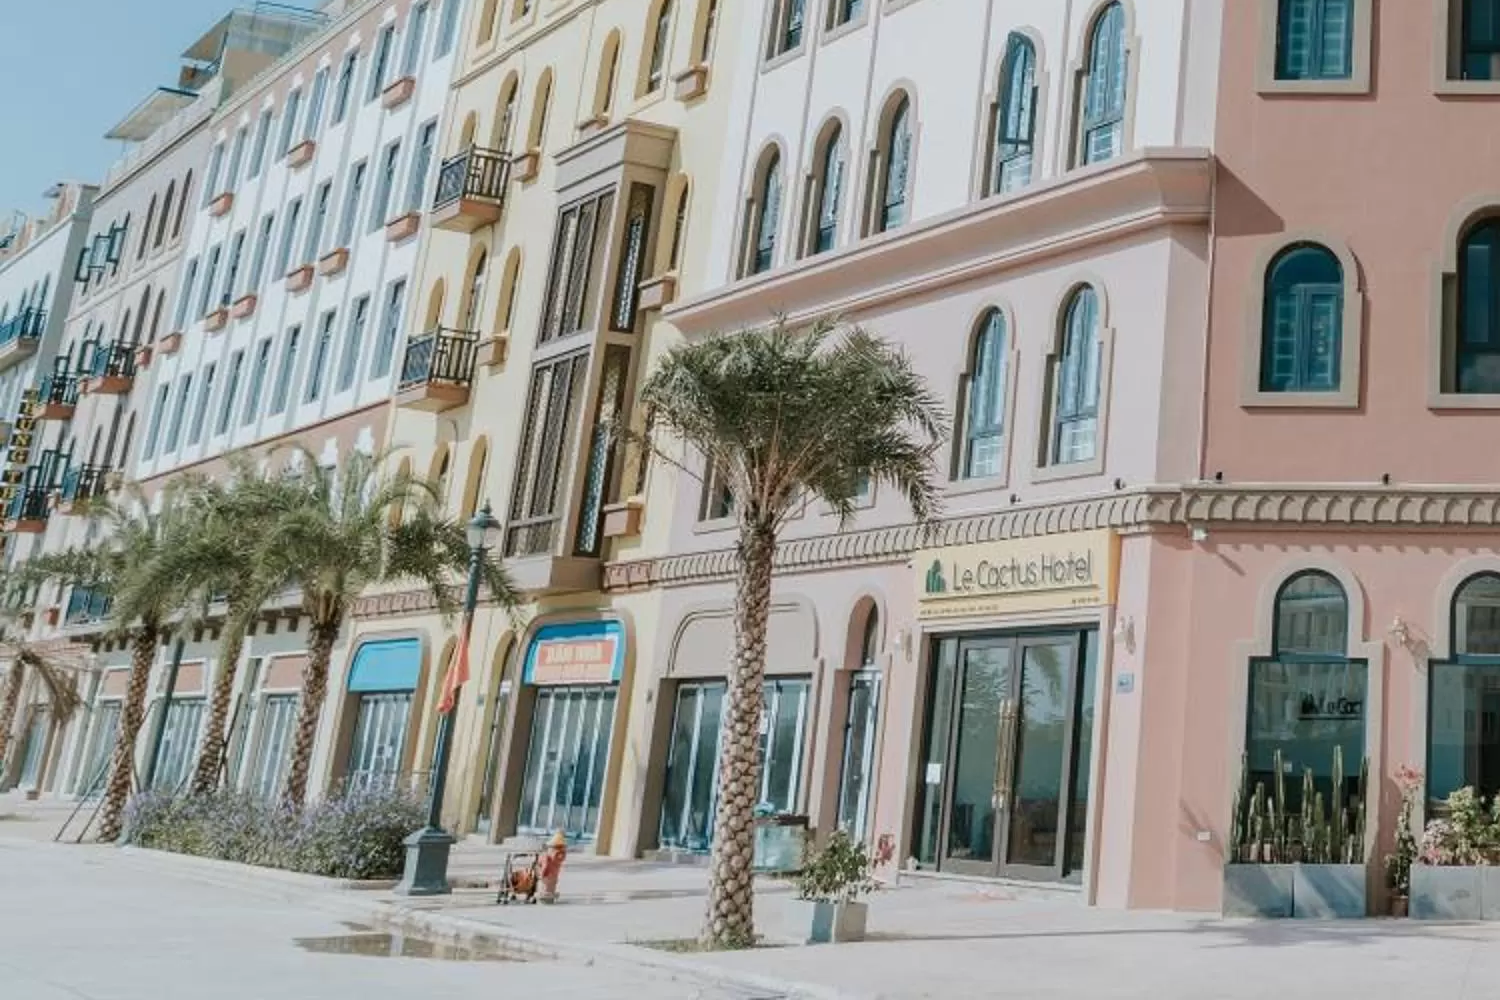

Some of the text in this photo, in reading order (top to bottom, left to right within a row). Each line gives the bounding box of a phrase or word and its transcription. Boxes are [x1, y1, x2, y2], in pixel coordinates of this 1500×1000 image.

[953, 549, 1092, 591] Le Cactus Hotel
